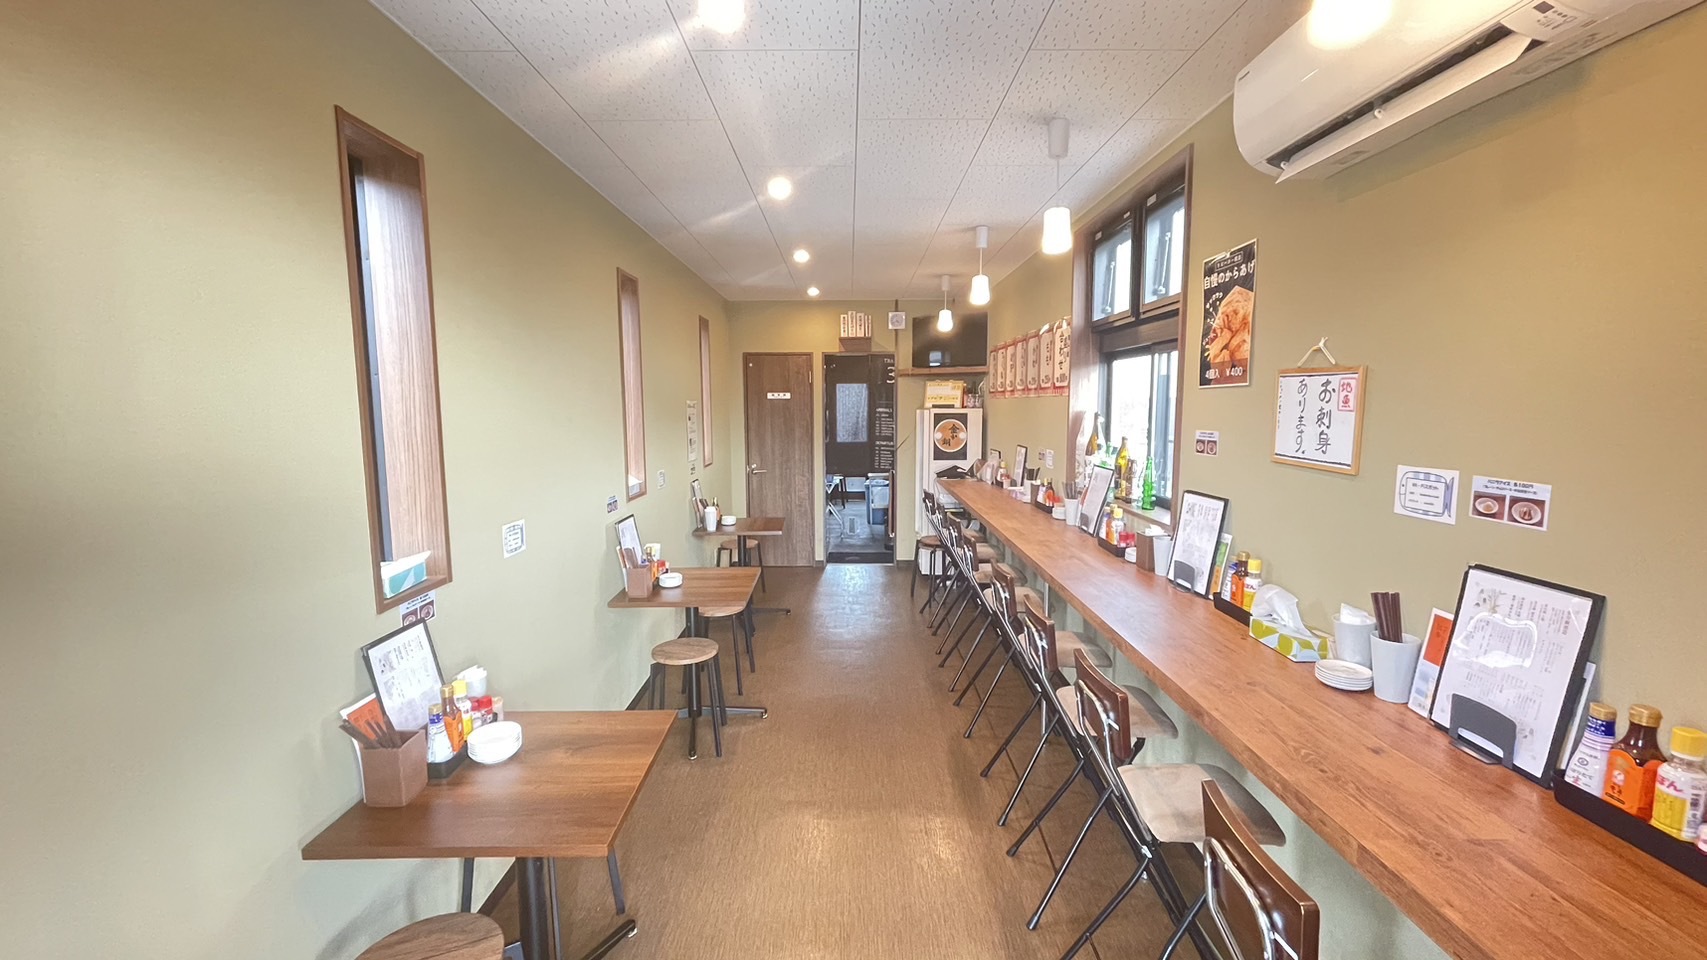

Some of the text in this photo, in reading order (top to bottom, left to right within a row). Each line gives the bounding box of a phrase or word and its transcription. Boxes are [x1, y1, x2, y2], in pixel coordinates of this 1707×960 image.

[1204, 261, 1255, 289] 自慢のからあげ
[1205, 367, 1243, 380] 4個入 ¥400
[1341, 381, 1353, 408] 地魚
[1295, 378, 1308, 454] あります。
[1315, 379, 1336, 454] お刺身
